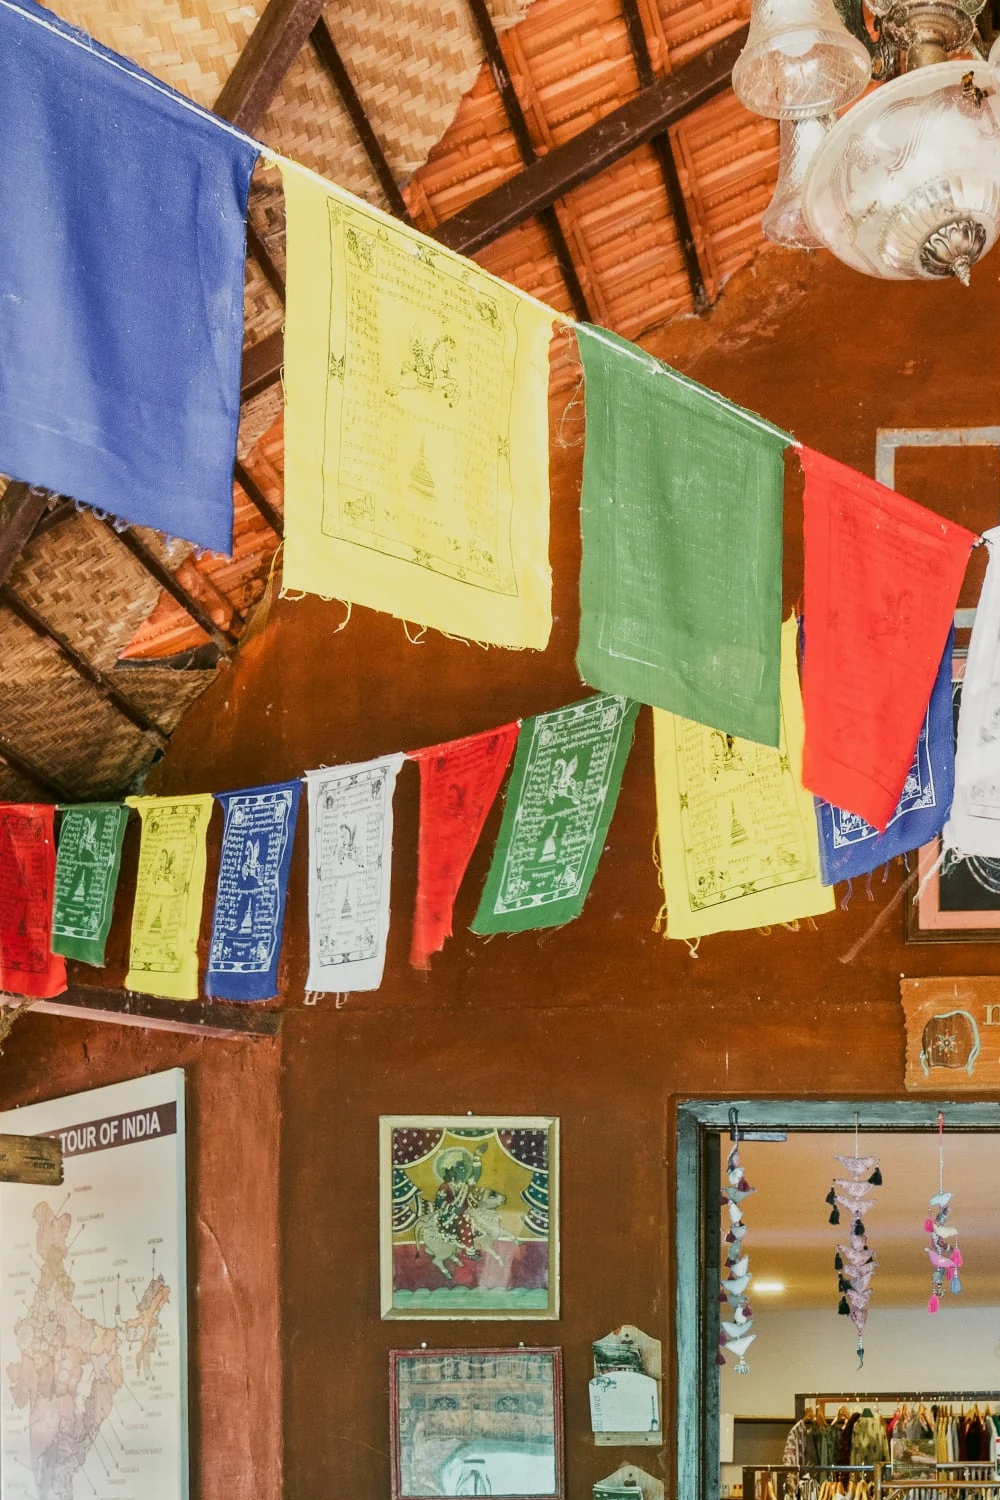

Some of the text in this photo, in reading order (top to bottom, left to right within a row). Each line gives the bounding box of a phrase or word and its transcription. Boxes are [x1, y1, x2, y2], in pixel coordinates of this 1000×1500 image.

[59, 1111, 160, 1154] TOUR OF INDIA
